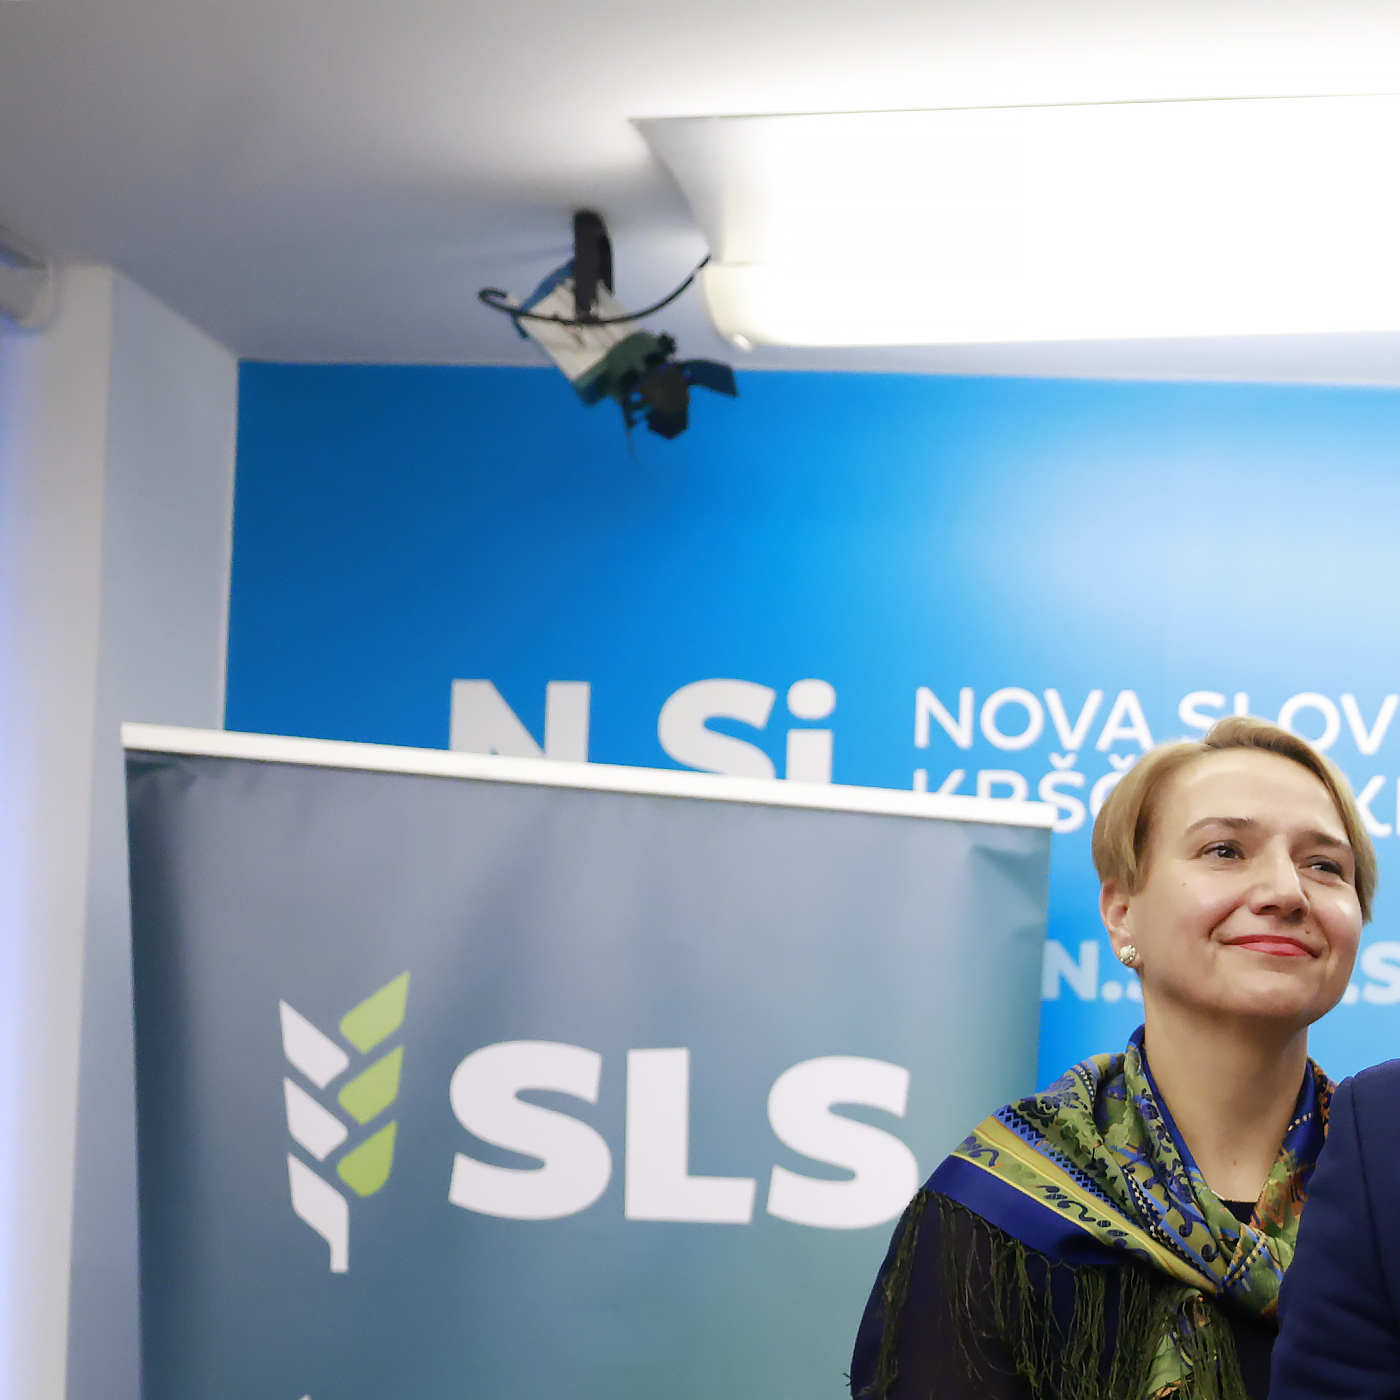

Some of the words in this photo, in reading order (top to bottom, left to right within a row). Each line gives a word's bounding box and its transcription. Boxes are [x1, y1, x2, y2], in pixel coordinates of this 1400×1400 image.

[449, 679, 836, 785] NSi
[913, 686, 1154, 752] NOVA
[449, 1040, 919, 1230] SLS
